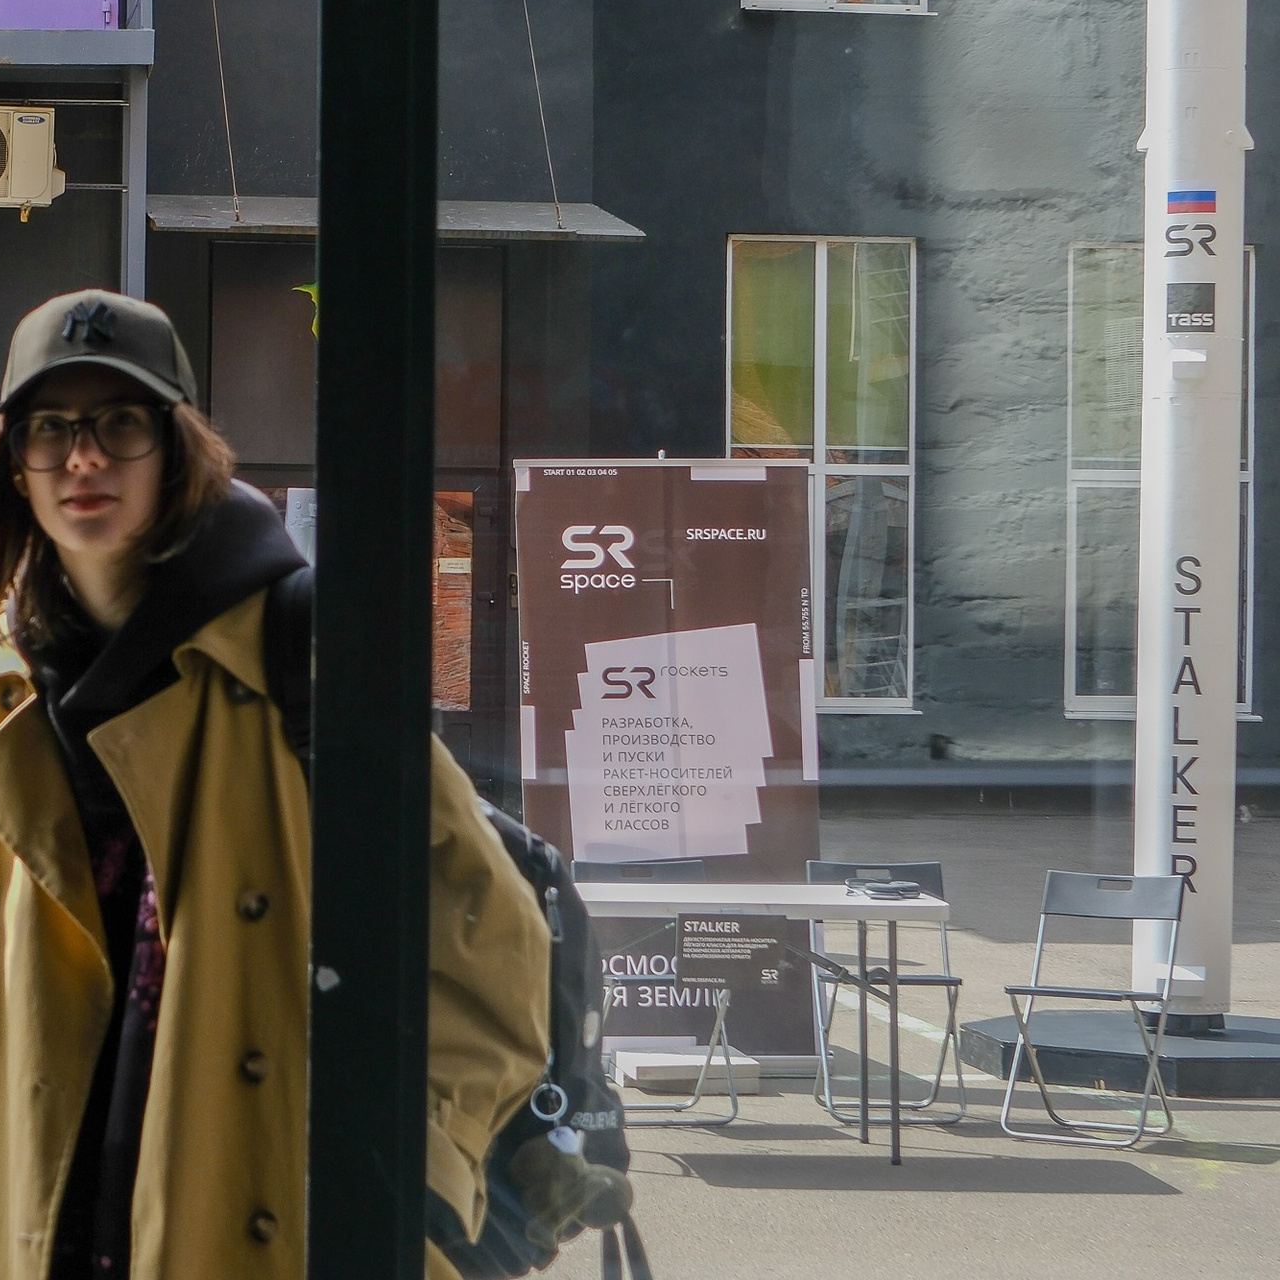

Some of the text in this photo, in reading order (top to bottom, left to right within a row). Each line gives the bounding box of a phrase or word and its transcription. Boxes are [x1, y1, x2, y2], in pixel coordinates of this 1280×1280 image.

[1164, 223, 1217, 257] SR
[686, 528, 767, 541] SRSPACE.RU
[560, 525, 635, 569] SR
[560, 573, 636, 594] space
[800, 587, 808, 598] TO
[801, 607, 810, 631] 55.755
[802, 632, 811, 654] FROM
[522, 640, 531, 695] SPACE ROCKET
[601, 665, 728, 699] SR rockets
[601, 717, 693, 730] РАЗРАБОТКА,
[1172, 556, 1203, 894] STALKER
[602, 734, 716, 747] ПРОИЗВОДСТВО
[603, 751, 665, 762] И ПУСКИ
[603, 766, 732, 780] РАКЕТ-НОСИТЕЛЕЙ
[603, 782, 707, 797] СВЕРХЛЁГКОГО
[604, 800, 680, 814] И ЛЁГКОГО
[604, 819, 670, 831] КЛАССОВ
[684, 921, 740, 933] STALKER
[761, 969, 780, 980] SR
[570, 1110, 618, 1130] BELIEVE
